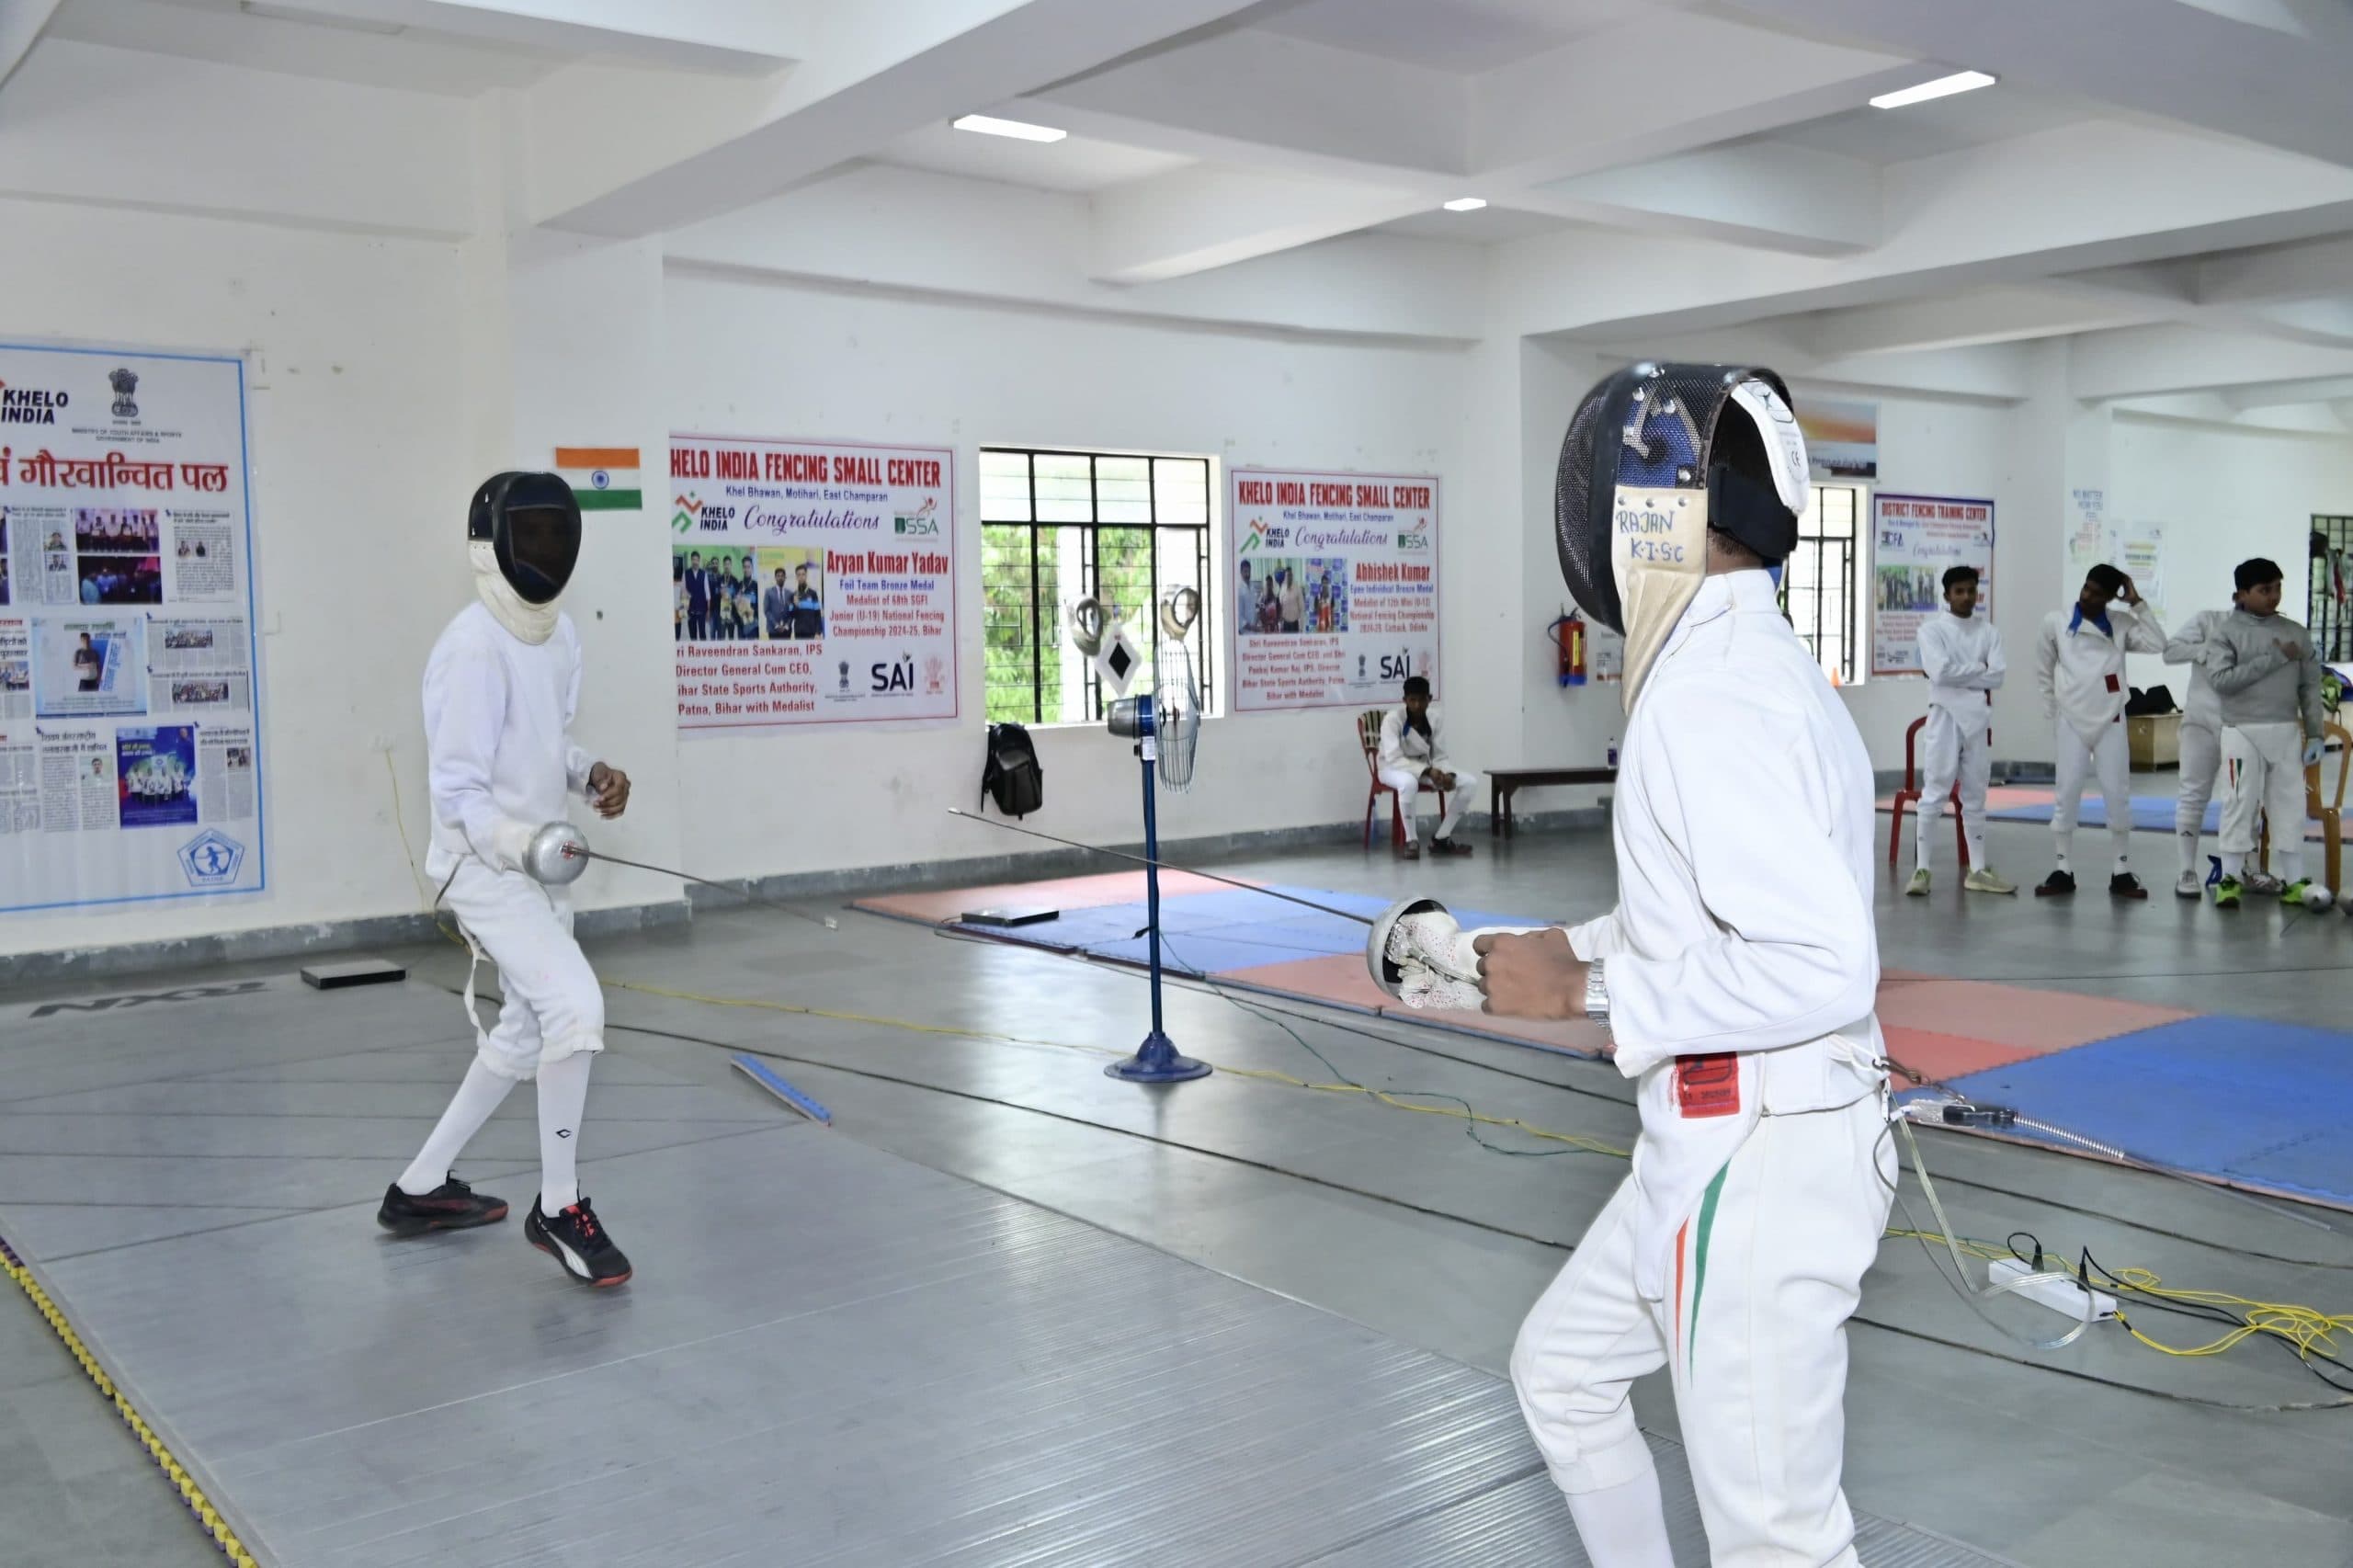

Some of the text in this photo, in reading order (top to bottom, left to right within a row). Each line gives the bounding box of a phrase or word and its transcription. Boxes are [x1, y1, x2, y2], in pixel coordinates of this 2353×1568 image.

[3, 389, 68, 407] KHELO
[1, 407, 55, 424] INDIA
[716, 450, 758, 480] INDIA
[765, 453, 827, 483] FENCING
[834, 457, 882, 485] SMALL
[888, 460, 940, 487] CENTER
[181, 464, 228, 491] पल
[726, 485, 745, 496] Khel
[747, 486, 783, 499] Bhawan,
[824, 489, 841, 500] East
[844, 490, 888, 504] Champaran
[1239, 481, 1430, 509] KHELO INDIA FENCING SMALL CENTER
[701, 506, 735, 518] KHELO
[744, 505, 880, 536] Congratulations
[699, 519, 728, 530] INDIA
[1616, 509, 1676, 534] RAJAN
[1267, 528, 1290, 538] KHELO
[1295, 526, 1387, 551] Congratulations
[1266, 539, 1284, 548] INDIA
[827, 551, 949, 576] Aryan Kumar Yadav
[1356, 562, 1430, 582] Abhishek Kumar
[840, 579, 935, 591] Foil Team Bronze Medal
[847, 594, 880, 606] Medalist
[882, 594, 890, 605] of
[830, 609, 854, 621] Junior
[882, 609, 914, 621] National
[916, 610, 945, 623] Fencing
[833, 626, 886, 639] Championship
[923, 626, 942, 637] Bihar
[688, 645, 749, 657] Raveendran
[753, 644, 802, 657] Sankaran,
[806, 643, 823, 655] IPS
[676, 665, 718, 677] Director
[722, 664, 761, 676] General
[765, 663, 786, 676] Cum
[1381, 654, 1410, 679] SAI
[871, 663, 914, 691] SAI
[701, 683, 729, 696] State
[733, 682, 766, 697] Sports
[678, 699, 815, 716] Patna, Bihar with Medalist
